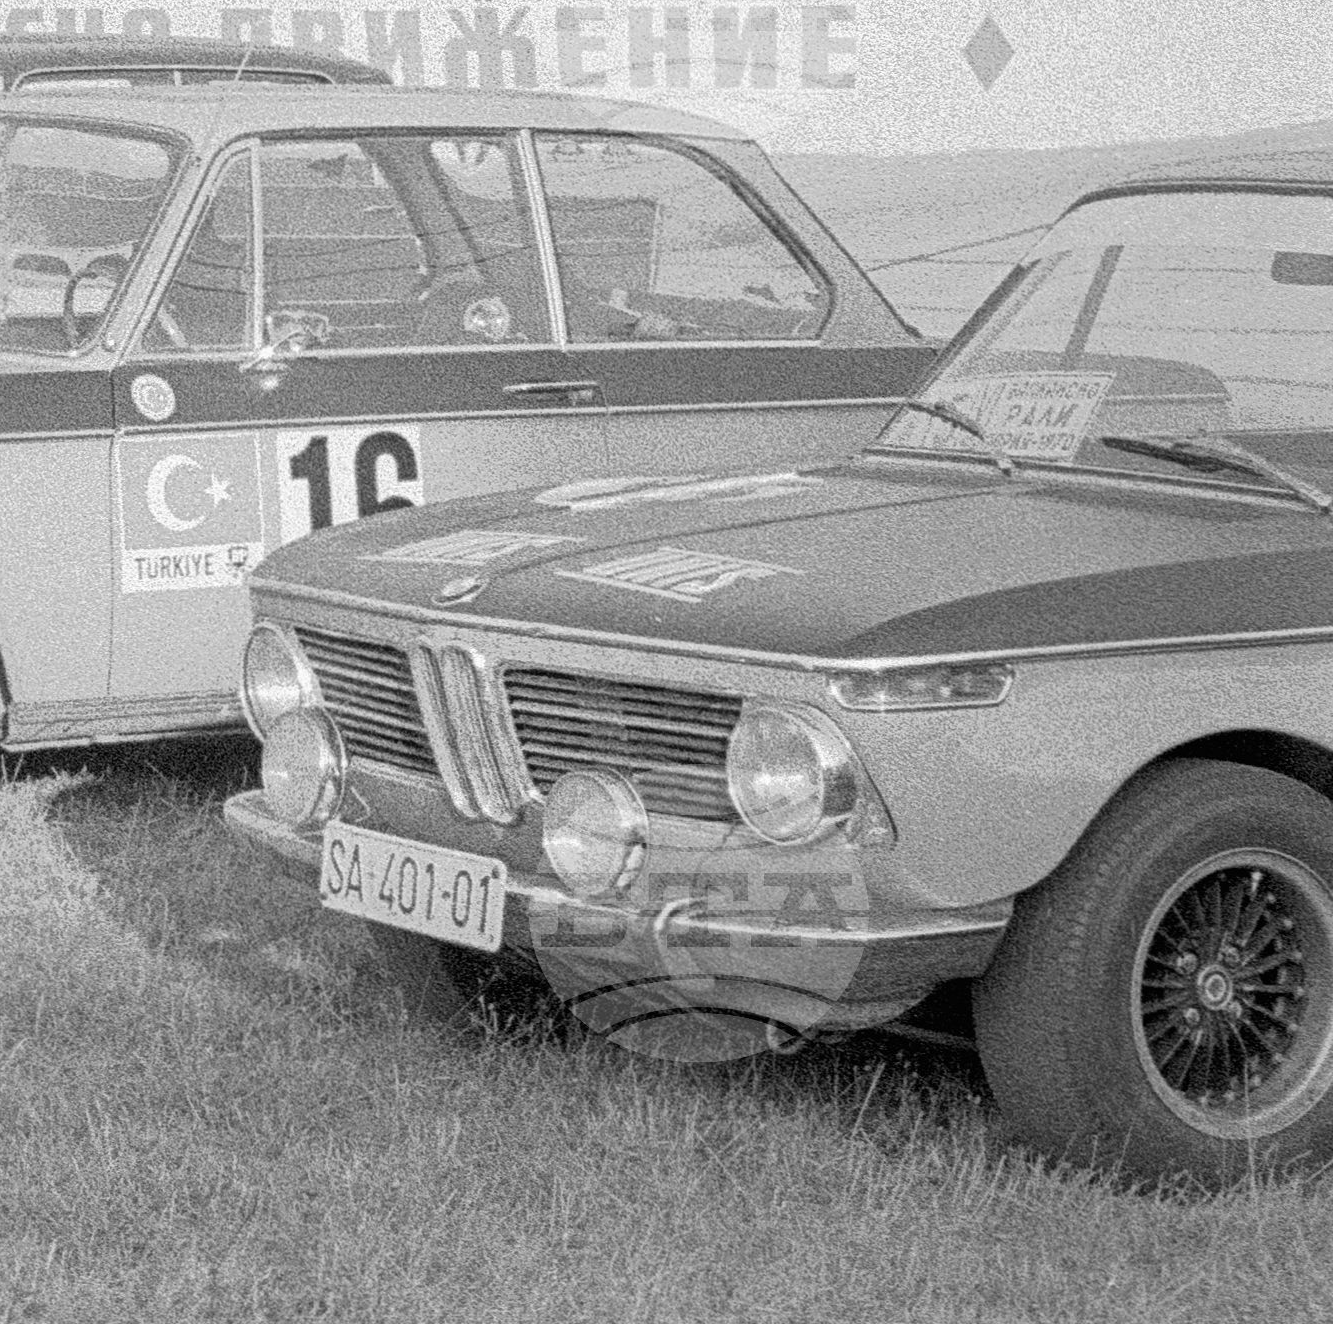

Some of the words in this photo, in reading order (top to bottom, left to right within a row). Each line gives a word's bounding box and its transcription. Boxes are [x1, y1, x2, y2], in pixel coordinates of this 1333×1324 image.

[289, 431, 419, 533] 16
[327, 839, 364, 903] SA
[378, 852, 491, 935] 401-01
